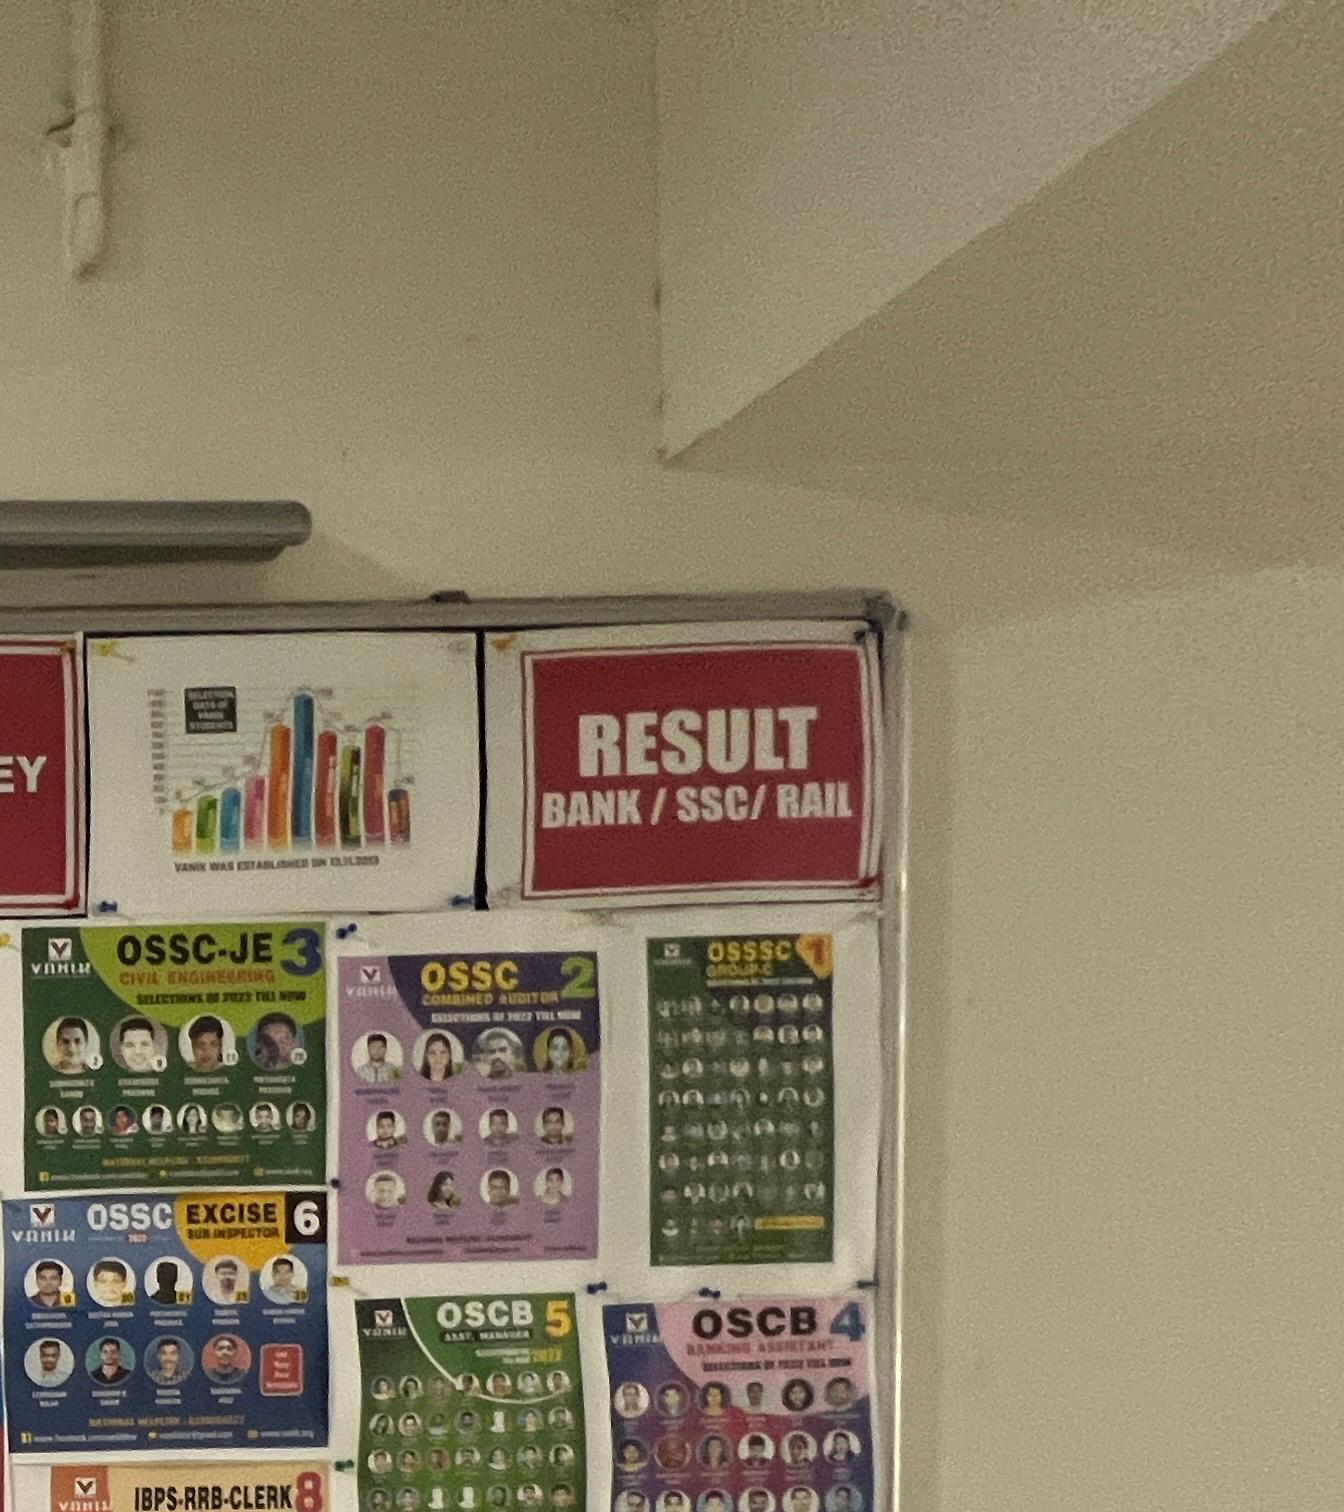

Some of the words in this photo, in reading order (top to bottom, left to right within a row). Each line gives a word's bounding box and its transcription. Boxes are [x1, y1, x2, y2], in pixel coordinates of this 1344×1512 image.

[577, 707, 818, 777] RESULT
[542, 783, 640, 829] BANK
[777, 782, 853, 819] RAIL
[174, 863, 206, 872] VANIK
[237, 858, 309, 870] ESTABLISHED
[117, 933, 273, 967] OSSC-JE
[280, 928, 323, 976] 3
[708, 940, 791, 962] OSSSC
[120, 972, 160, 986] CIVIL
[167, 969, 274, 984] ENGINEERING
[420, 961, 518, 992] OSSC
[560, 956, 595, 998] 2
[86, 1203, 172, 1231] OSSC
[186, 1202, 277, 1224] EXCISE
[294, 1201, 319, 1235] 6
[213, 1228, 280, 1239] INSPECTOR
[437, 1301, 533, 1328] OSCB
[545, 1301, 572, 1337] 5
[693, 1306, 817, 1340] OSCB
[830, 1302, 865, 1341] 4
[134, 1485, 293, 1511] IBPS-RRB-CLERK
